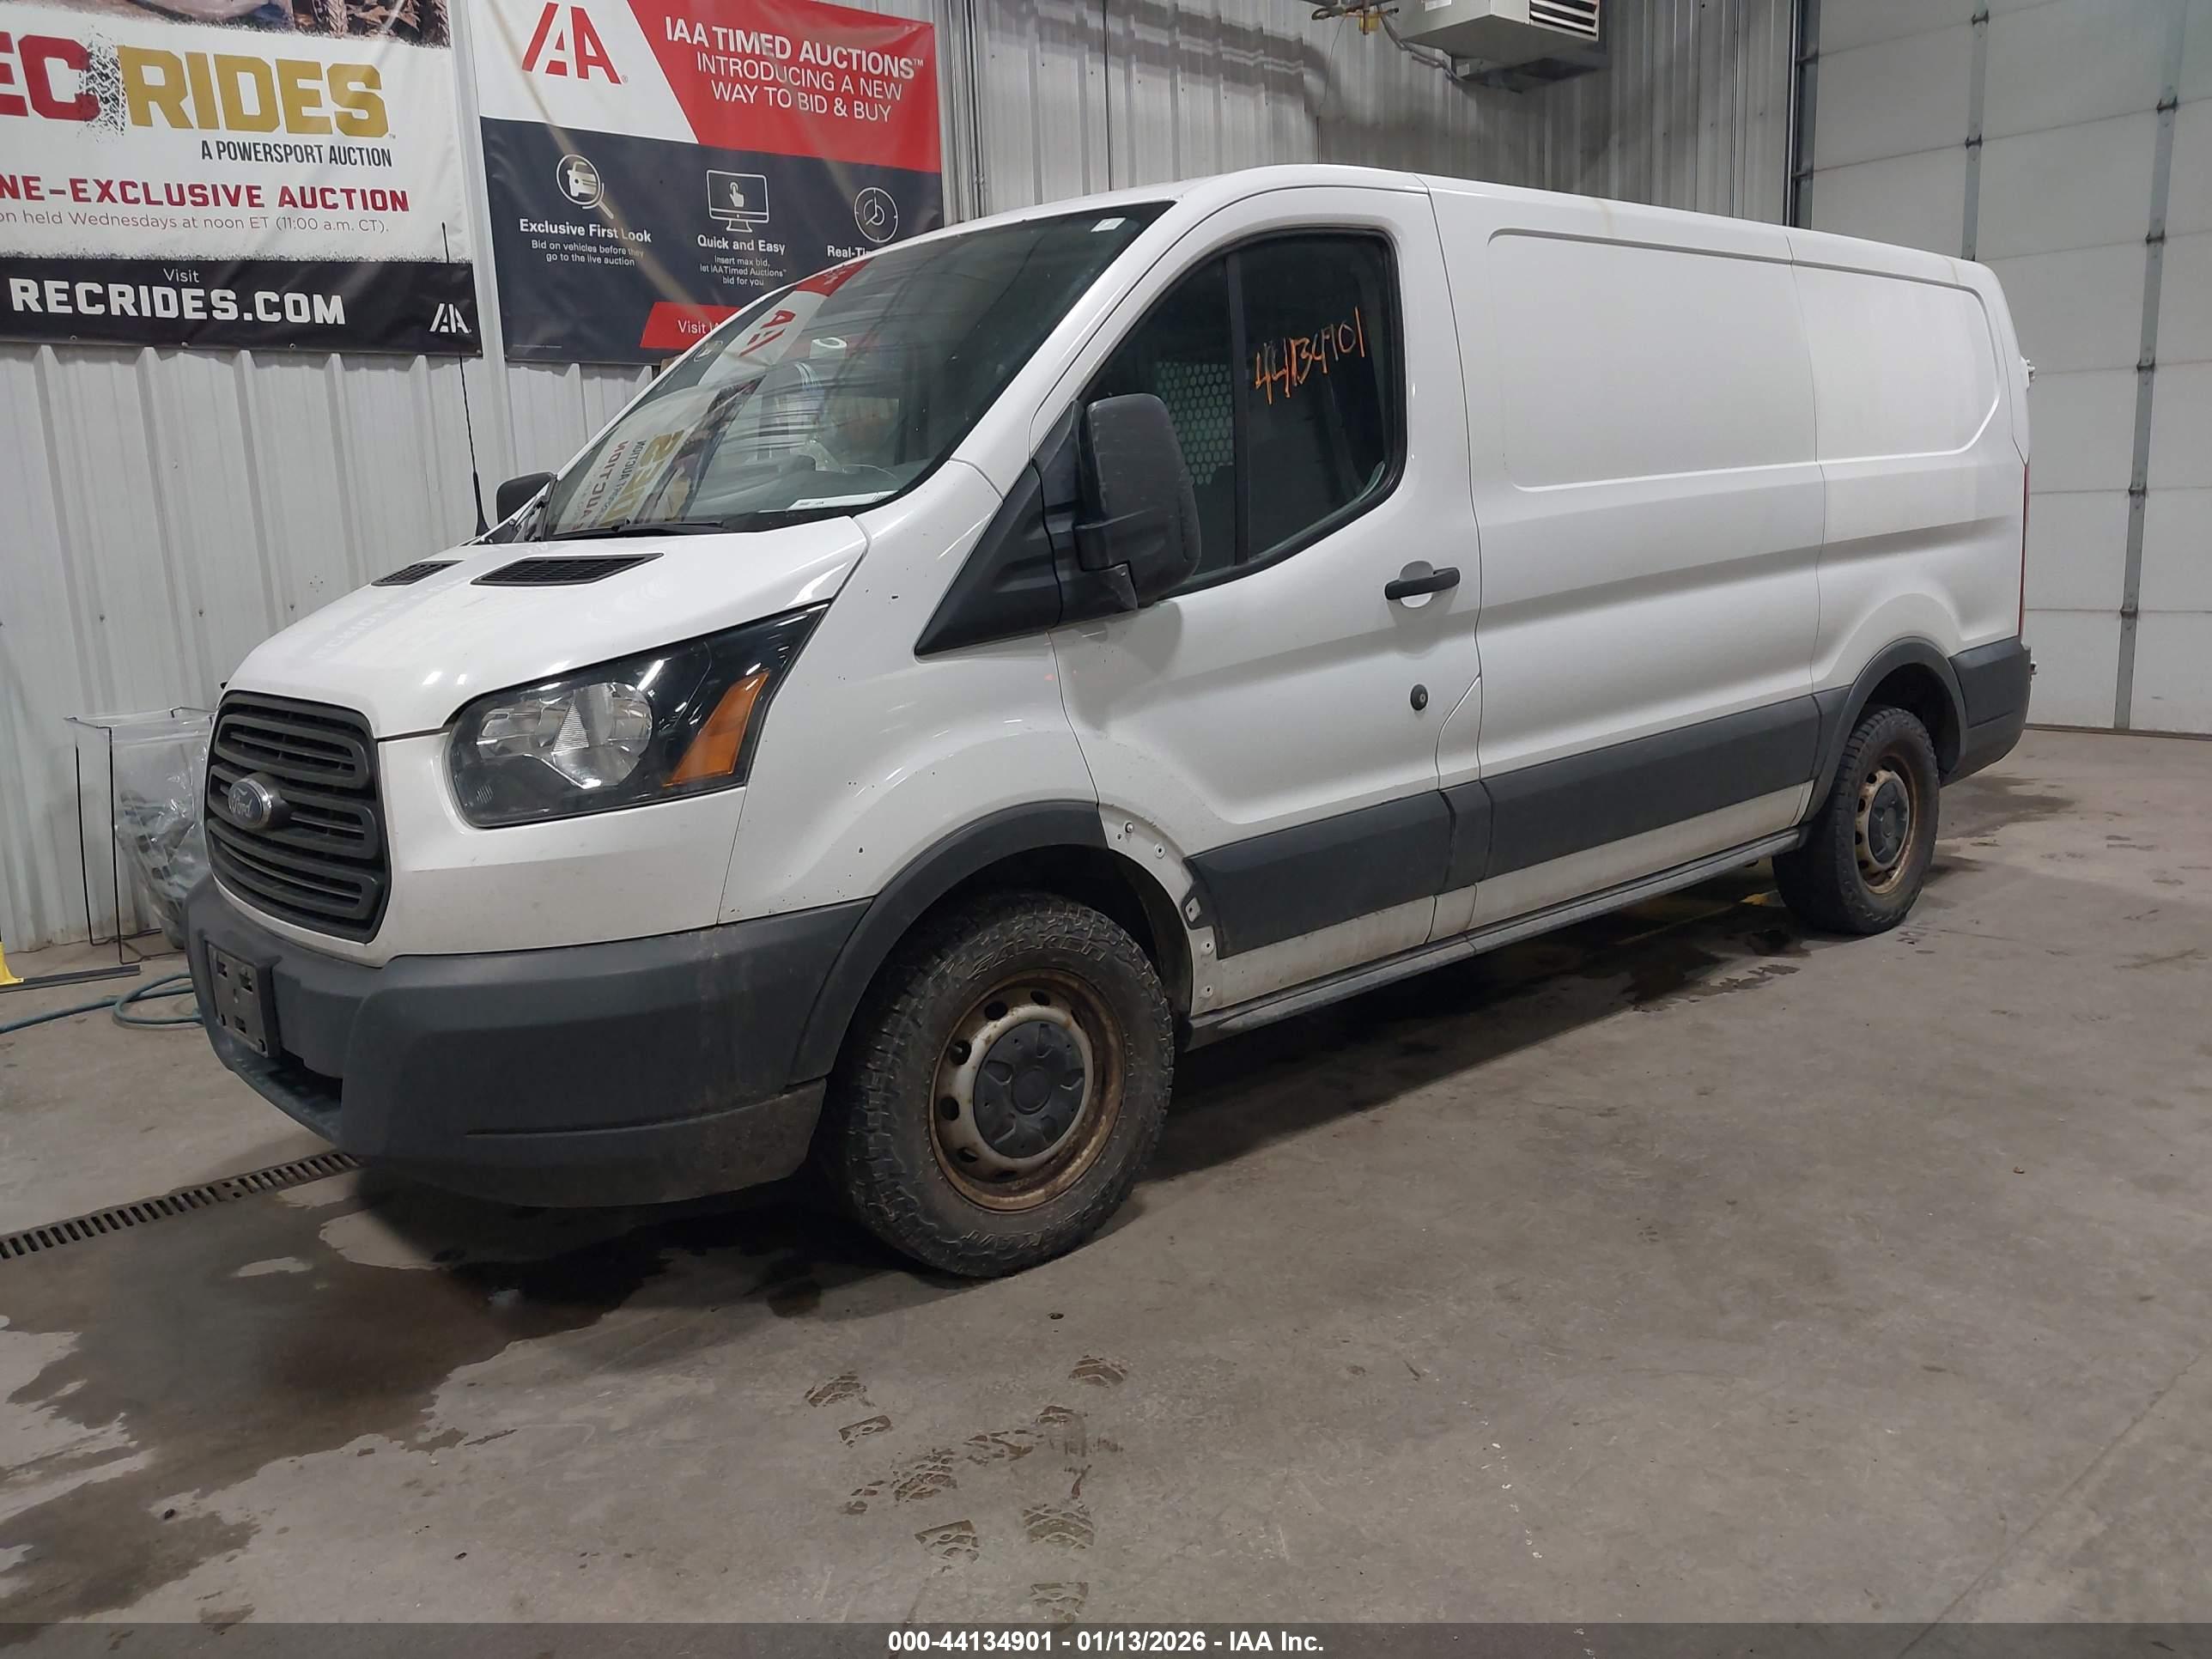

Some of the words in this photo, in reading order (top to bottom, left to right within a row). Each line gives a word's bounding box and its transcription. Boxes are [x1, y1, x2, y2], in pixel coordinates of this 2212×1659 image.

[665, 15, 709, 47] IAA
[712, 26, 792, 60] TIMED
[696, 52, 835, 93] INTRODUCING
[841, 75, 854, 95] A
[860, 77, 902, 101] NEW
[711, 80, 758, 105] WAY
[764, 87, 792, 109] TO
[798, 92, 828, 114] BID
[833, 97, 848, 118] &
[854, 100, 892, 124] BUY
[201, 140, 214, 161] A
[216, 140, 324, 164] POWERSPORT
[329, 145, 393, 167] AUCTION
[277, 185, 410, 212] AUCTION
[22, 210, 63, 225] held
[68, 211, 178, 230] Wednesdays
[182, 216, 198, 229] at
[204, 218, 245, 228] noon
[250, 216, 269, 229] ET
[276, 216, 319, 231] (11:00
[324, 220, 355, 232] a.m.
[359, 219, 389, 234] CT).
[520, 218, 586, 236] Exclusive
[589, 223, 619, 240] First
[622, 228, 653, 244] Look
[532, 240, 547, 250] Bid
[563, 242, 598, 253] vehicles
[599, 245, 627, 256] before
[629, 247, 645, 258] they
[697, 234, 729, 251] Quick
[732, 240, 755, 251] and
[758, 240, 786, 256] Easy
[546, 253, 558, 263] go
[560, 252, 569, 262] to
[572, 253, 586, 263] the
[587, 253, 602, 264] live
[604, 255, 635, 266] auction
[700, 264, 709, 272] let
[723, 265, 749, 276] Timed
[714, 255, 736, 265] Insert
[756, 258, 770, 268] bid,
[163, 267, 199, 283] Visit
[723, 276, 735, 285] bid
[737, 276, 747, 285] for
[750, 278, 764, 288] you
[9, 277, 346, 325] RECRIDES.COM
[678, 319, 706, 334] Visit
[1255, 306, 1365, 405] 44134901
[232, 786, 253, 818] Ford
